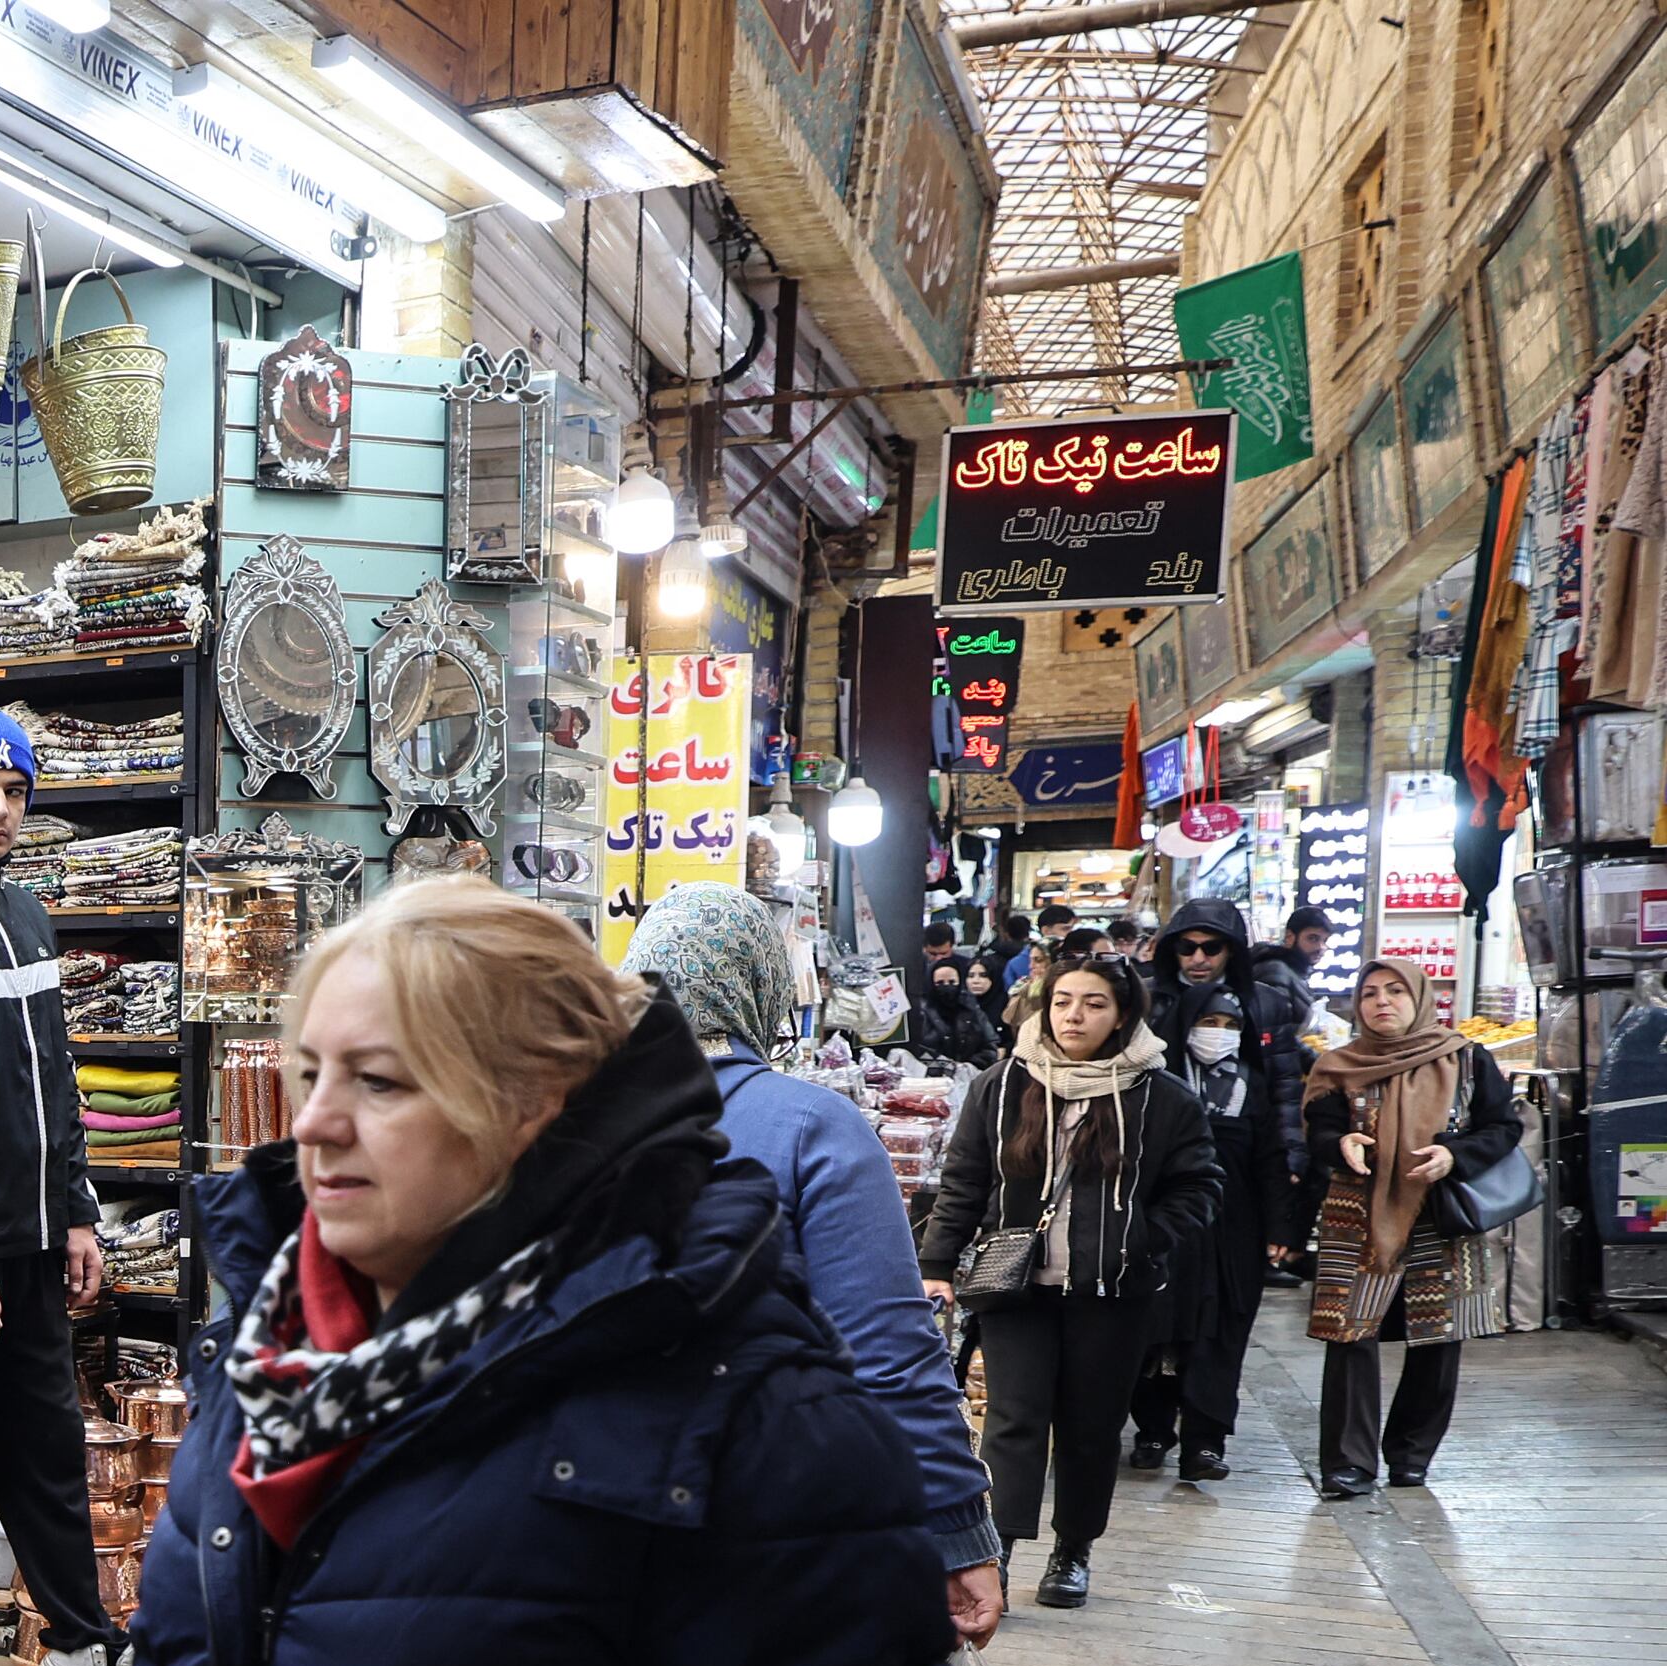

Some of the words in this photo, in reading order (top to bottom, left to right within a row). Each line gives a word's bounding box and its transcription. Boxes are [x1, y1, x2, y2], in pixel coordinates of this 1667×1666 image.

[79, 38, 142, 101] VINEX
[193, 110, 244, 162] VINEX
[291, 169, 336, 215] VINEX
[956, 438, 1029, 490] تاک
[1033, 434, 1108, 493] تیک
[1113, 427, 1222, 480] ساعت
[1001, 501, 1165, 549] تعمیرات
[956, 557, 1068, 602] باطری
[1145, 552, 1204, 594] بند
[950, 630, 1016, 655] ساعت
[611, 655, 737, 715] گالری
[962, 678, 1007, 707] بند
[613, 740, 731, 783] ساعت
[606, 813, 665, 851] تاک
[672, 813, 735, 859] تیک
